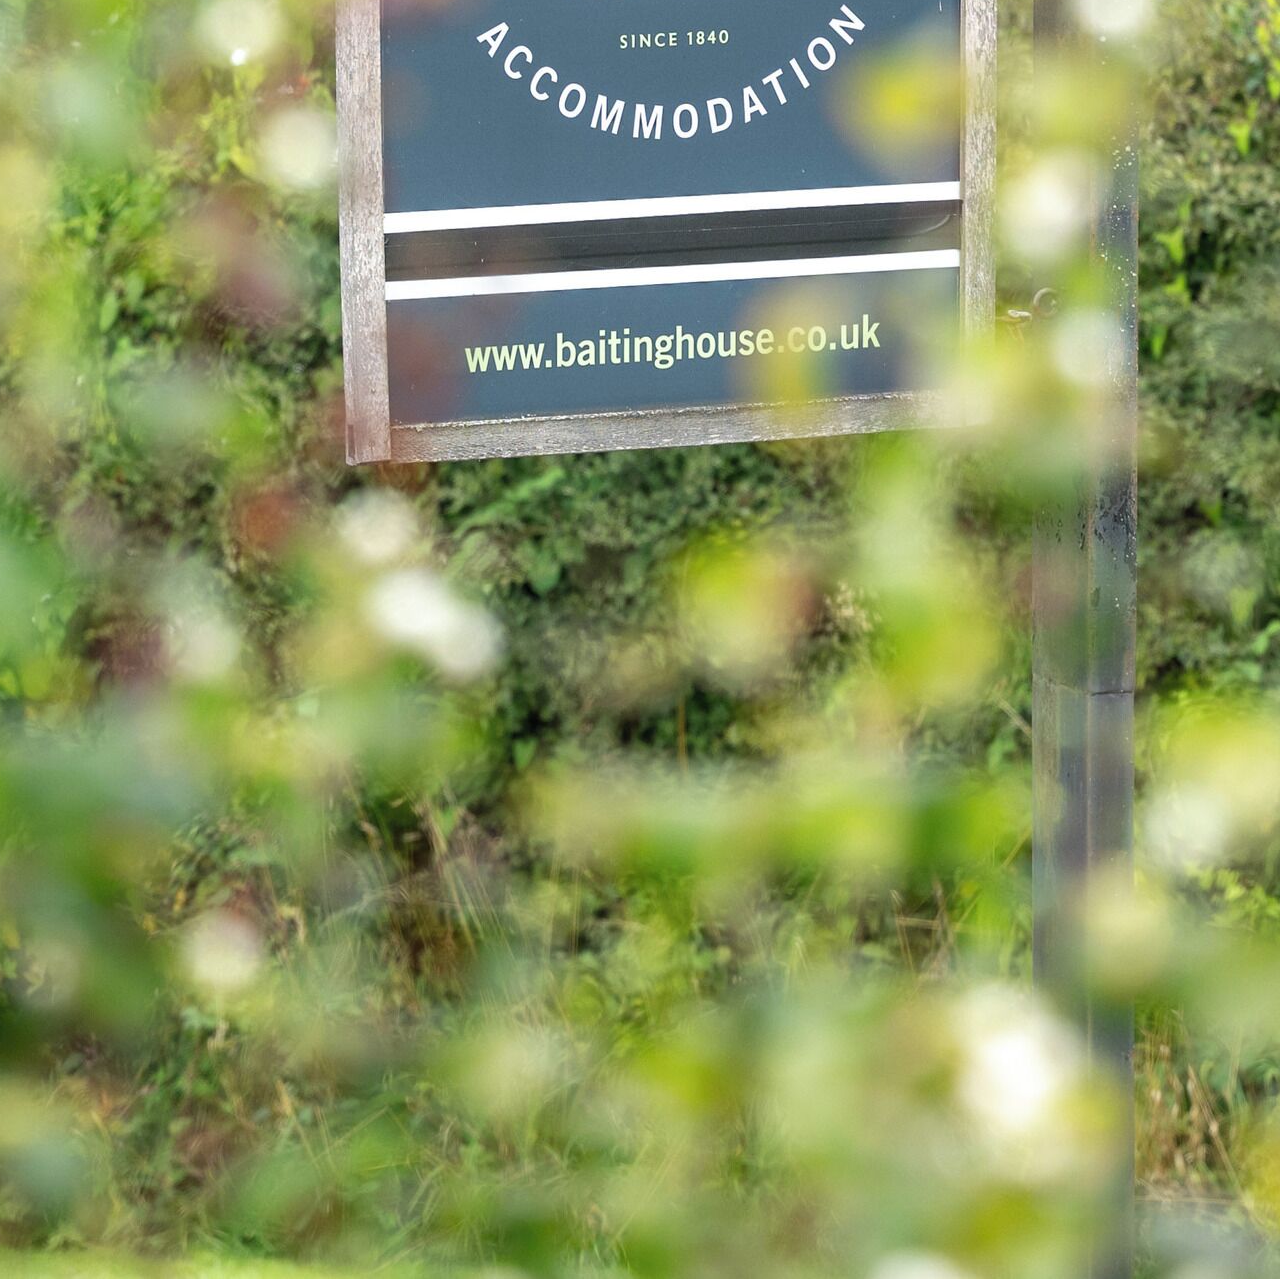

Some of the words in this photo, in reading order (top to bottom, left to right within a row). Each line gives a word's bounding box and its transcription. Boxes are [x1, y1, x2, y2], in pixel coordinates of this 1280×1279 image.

[620, 32, 677, 48] SINCE
[687, 29, 729, 45] 1840
[477, 4, 866, 139] ACCOMMODATION
[465, 314, 880, 373] www.baitinghouse.co.uk
